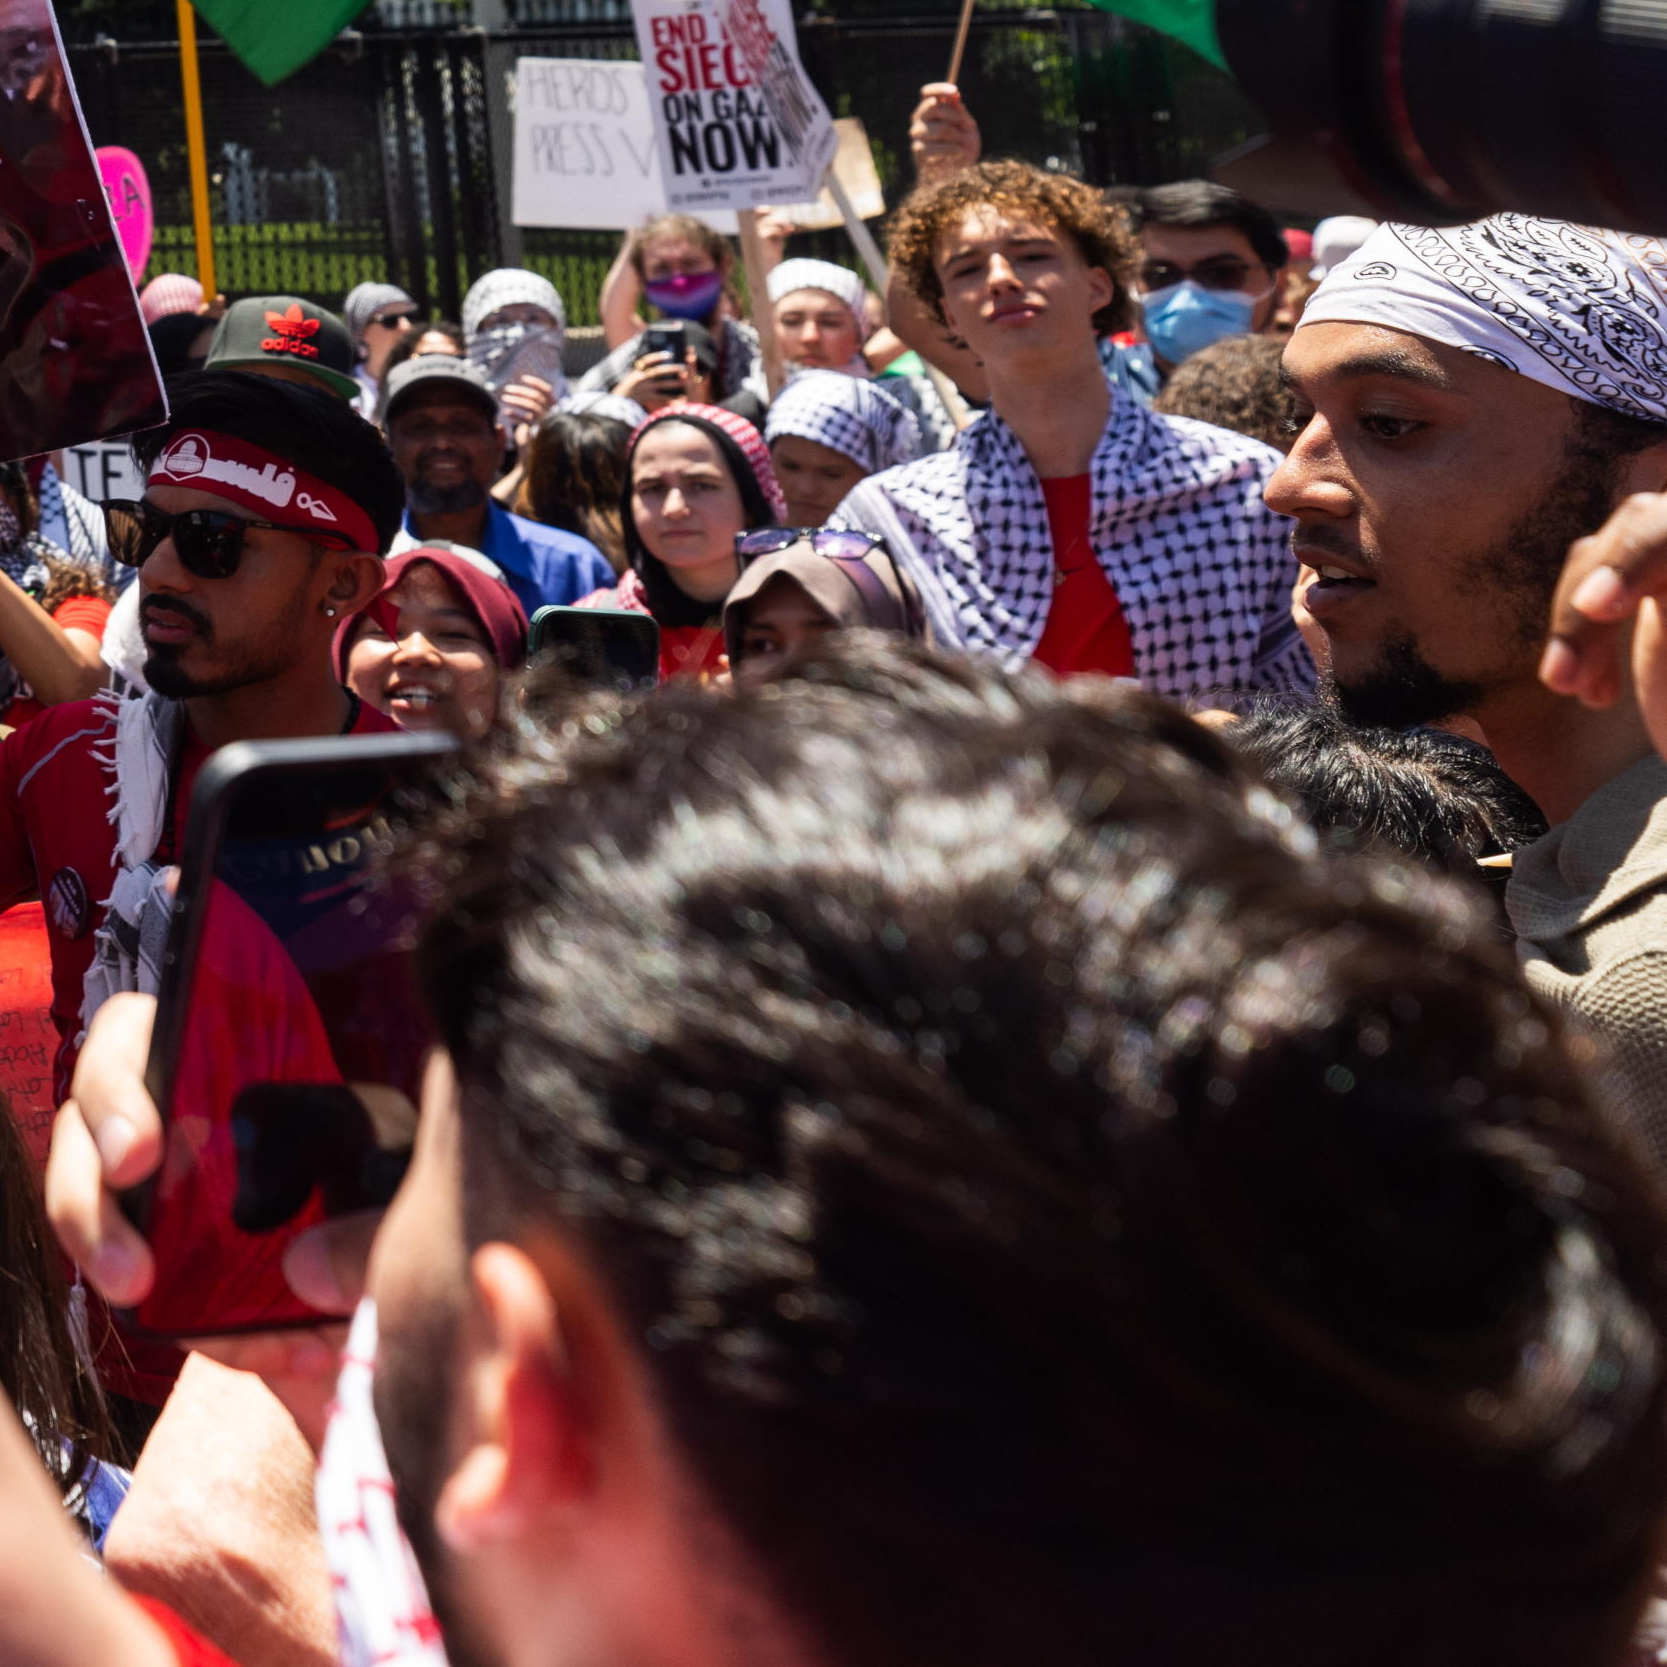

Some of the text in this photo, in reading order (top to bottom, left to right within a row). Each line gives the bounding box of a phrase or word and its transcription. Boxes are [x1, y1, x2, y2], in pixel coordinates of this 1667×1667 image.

[651, 14, 707, 47] END
[662, 90, 704, 123] ON
[260, 337, 320, 359] adidas
